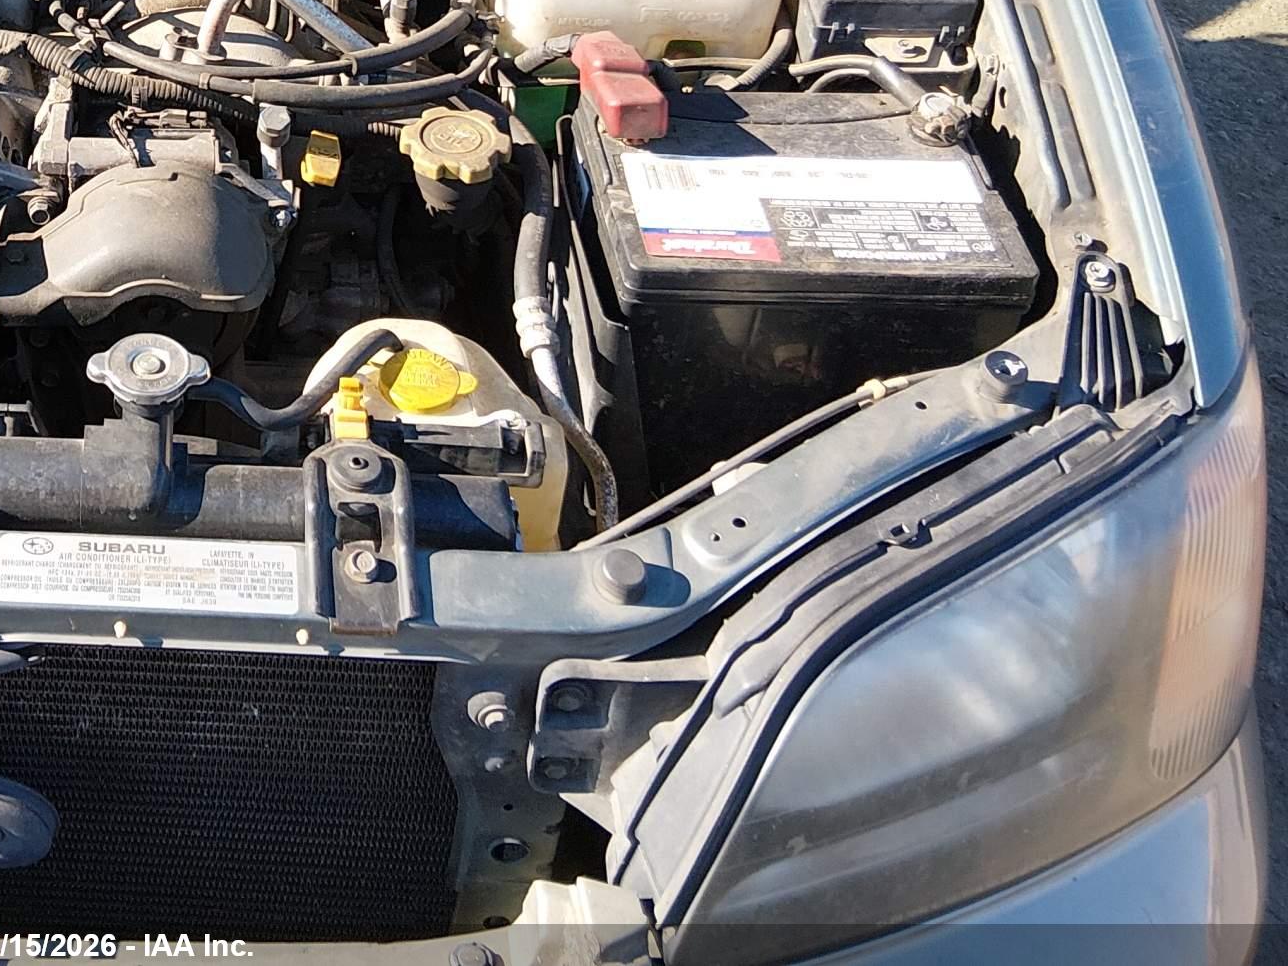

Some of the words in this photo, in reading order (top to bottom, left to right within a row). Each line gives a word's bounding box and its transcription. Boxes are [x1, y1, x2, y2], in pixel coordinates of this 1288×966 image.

[78, 541, 166, 555] SUBARU
[76, 554, 130, 563] CONDITIONER
[202, 559, 249, 568] CLIMATISEUR
